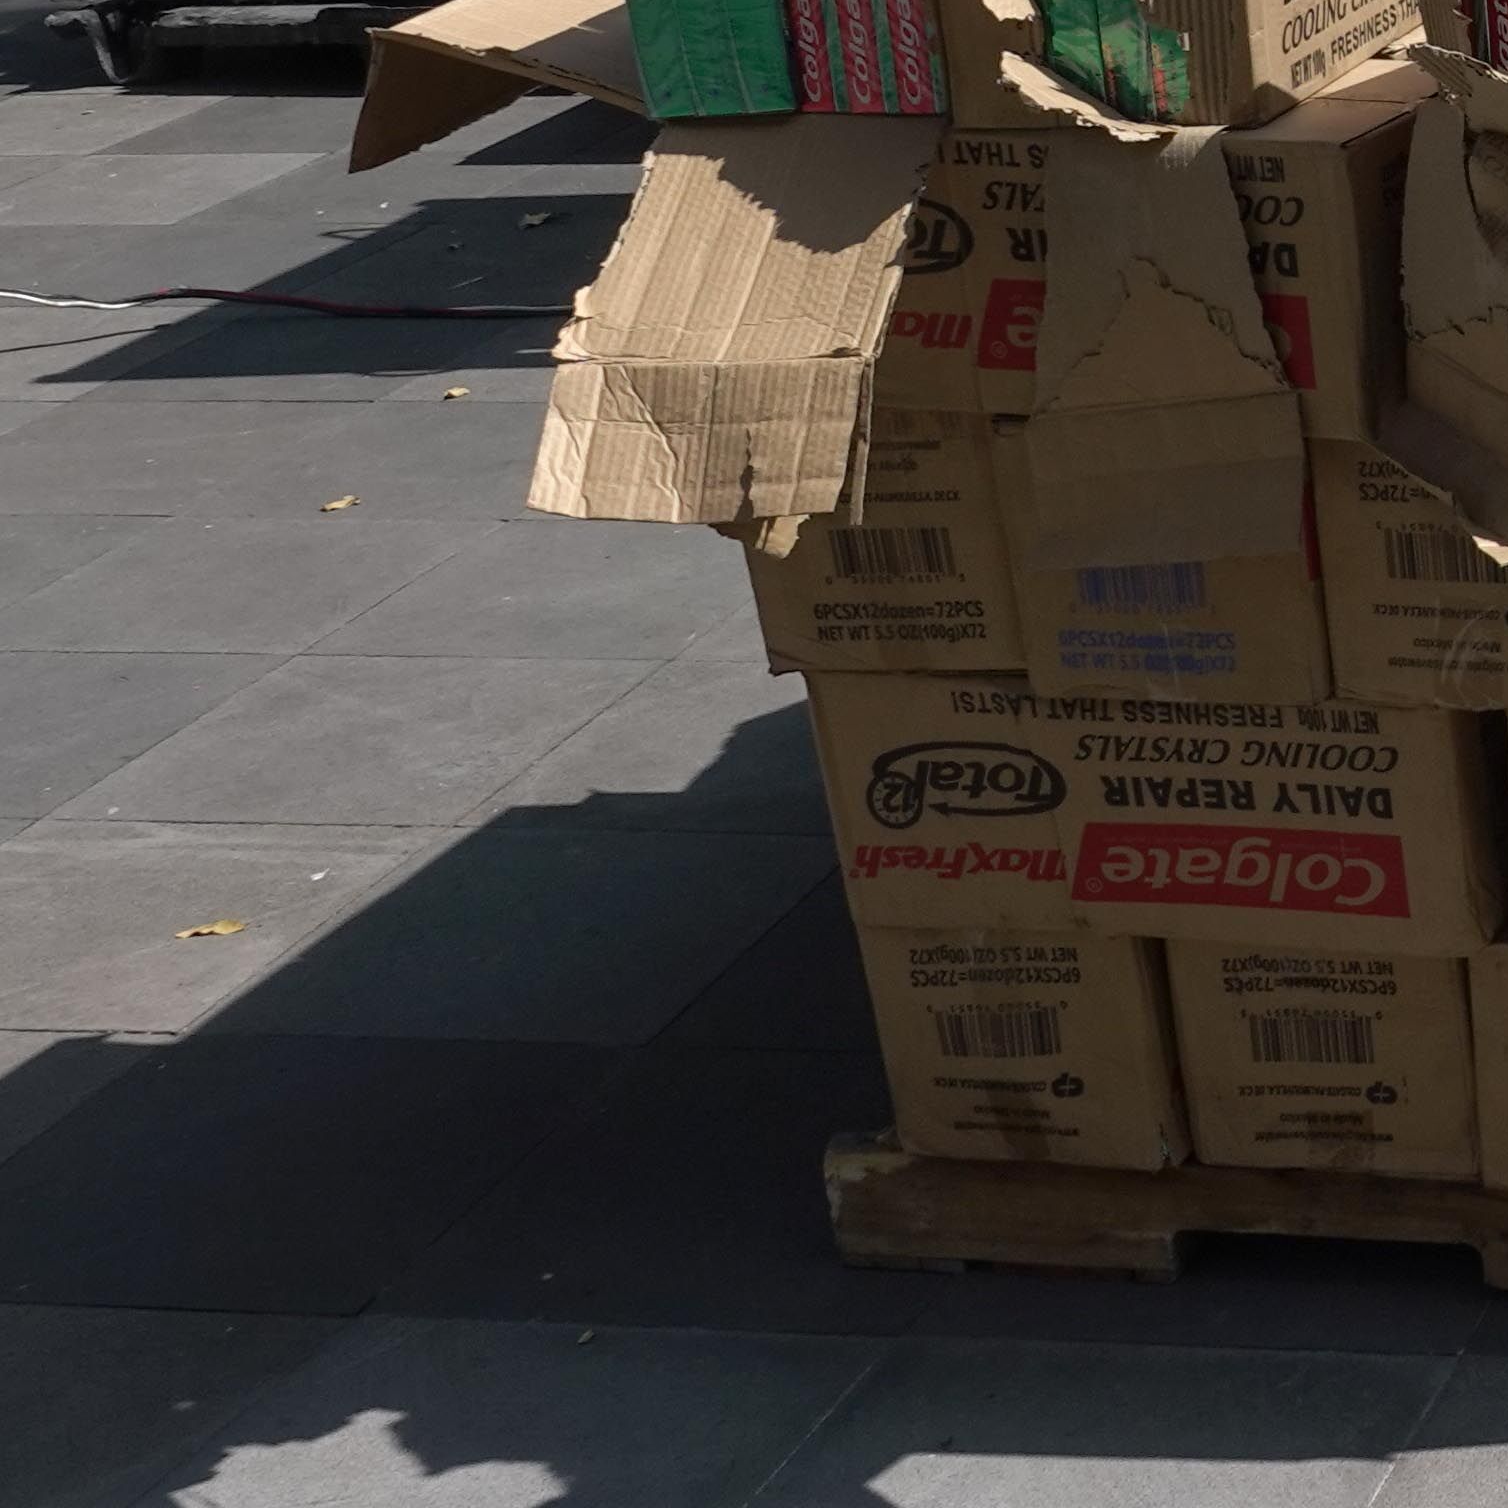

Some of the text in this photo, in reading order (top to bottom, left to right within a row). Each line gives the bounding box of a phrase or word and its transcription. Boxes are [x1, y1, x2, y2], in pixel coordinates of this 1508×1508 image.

[1331, 9, 1397, 69] FRESHNESS
[952, 692, 1039, 718] LASTS!
[1046, 698, 1115, 721] THAT
[1121, 700, 1284, 728] FRESHNESS
[1330, 709, 1353, 734] WT
[1355, 710, 1379, 734] NET
[1073, 735, 1398, 773] COOLING CRYSTALS
[915, 759, 1046, 807] Total
[1103, 775, 1394, 819] DAILY REPAIR
[858, 842, 1387, 907] Colgate MaxFresh
